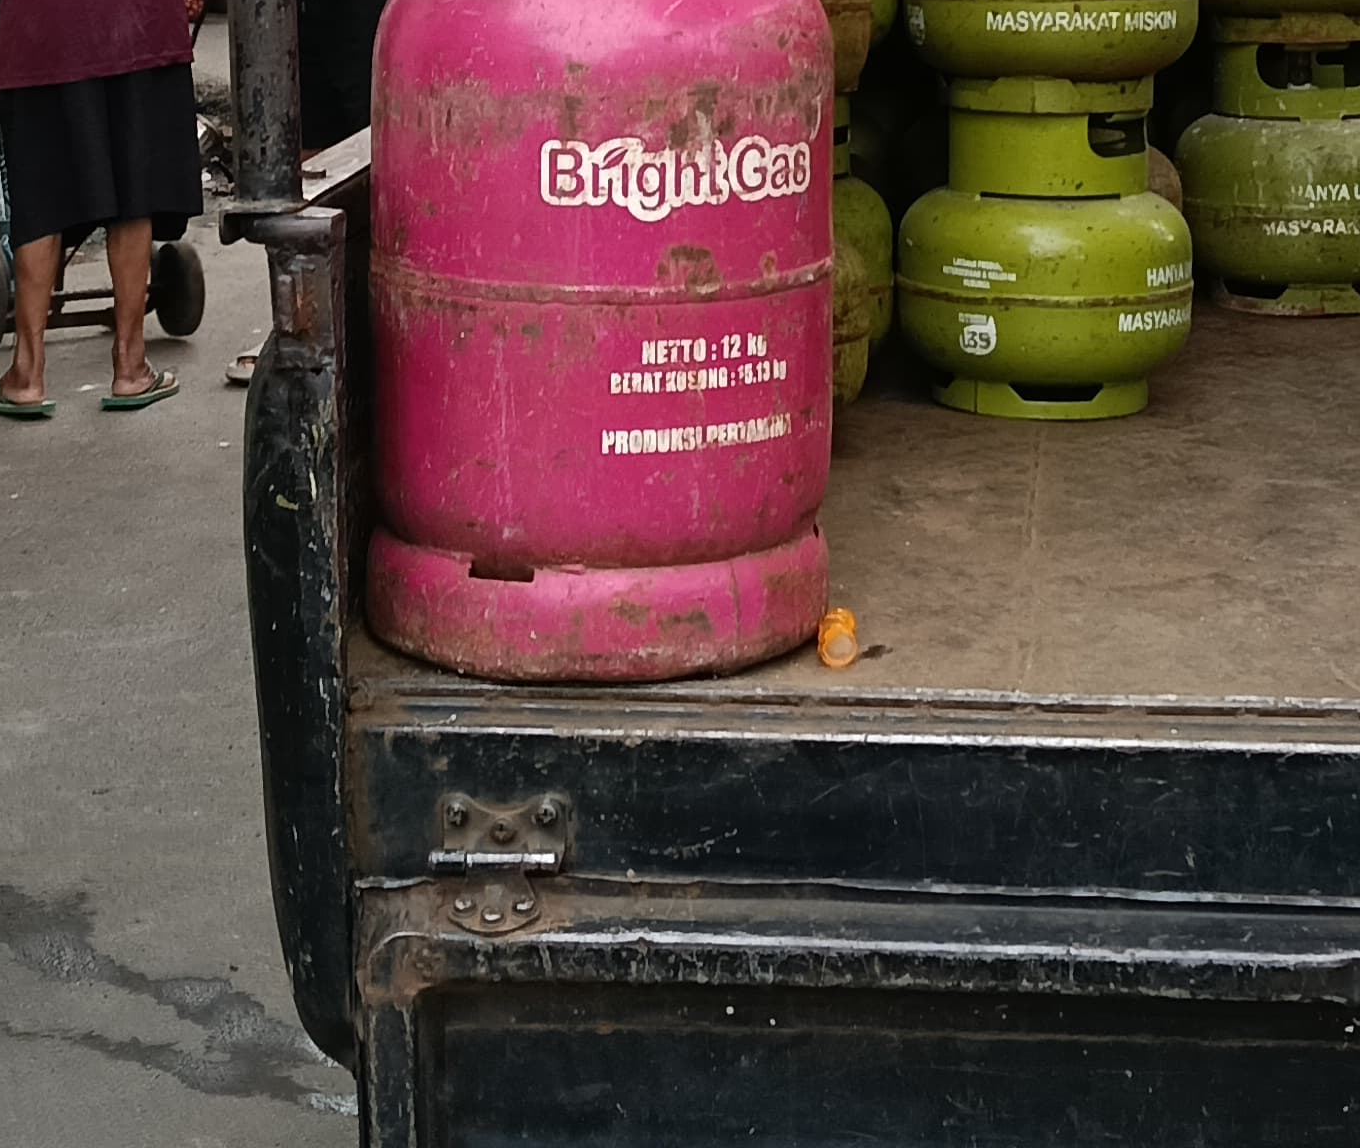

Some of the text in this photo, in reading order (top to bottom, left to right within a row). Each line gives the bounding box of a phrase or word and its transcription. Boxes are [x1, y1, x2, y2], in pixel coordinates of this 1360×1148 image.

[986, 9, 1177, 33] MASYARAKAT MISKIN
[543, 137, 811, 219] Bright Gas
[642, 338, 707, 365] NETTO
[720, 334, 742, 359] 12
[610, 371, 663, 395] BERAT
[665, 366, 729, 393] KOSONG
[601, 426, 704, 455] PRODUKSI
